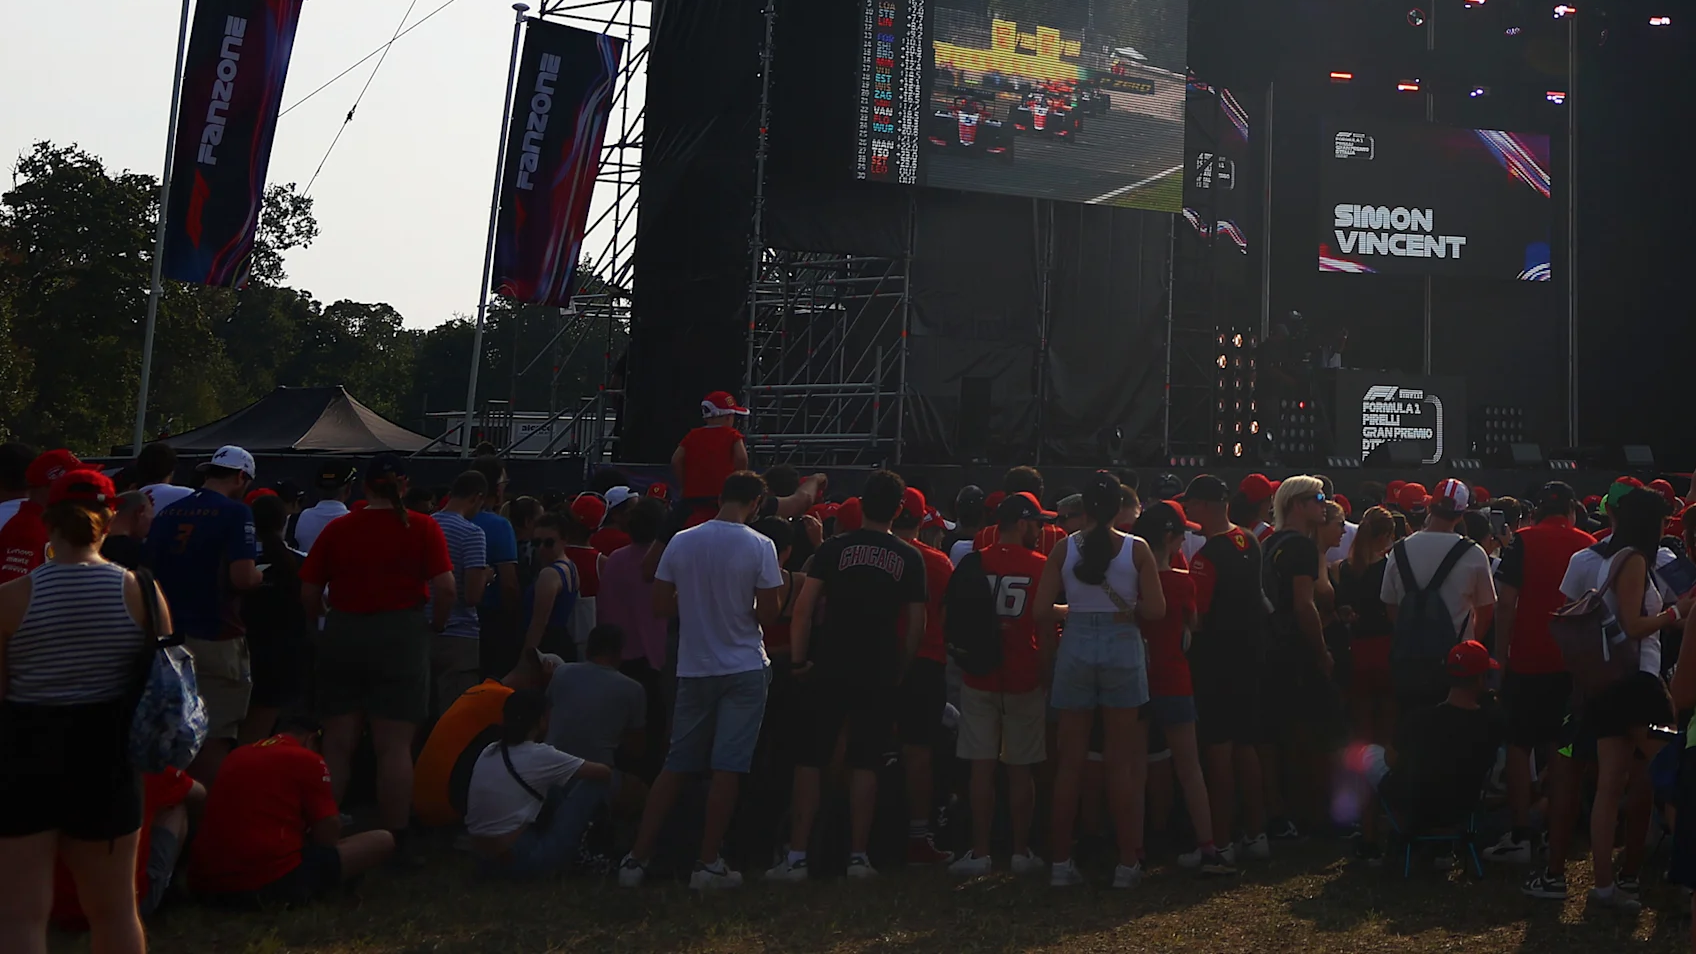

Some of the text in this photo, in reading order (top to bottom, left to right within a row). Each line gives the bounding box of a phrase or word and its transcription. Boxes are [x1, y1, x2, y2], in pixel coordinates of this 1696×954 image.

[875, 73, 892, 83] EST
[874, 89, 893, 101] ZAG
[873, 106, 893, 117] VAN
[872, 122, 894, 134] WUR
[1334, 203, 1434, 233] SIMON
[1334, 229, 1467, 260] VINCENT
[1362, 401, 1422, 414] FORMULA 1
[1362, 413, 1400, 426] PIRELLI
[1362, 426, 1434, 440] GRAN PREMIO
[838, 544, 905, 582] CHICAGO
